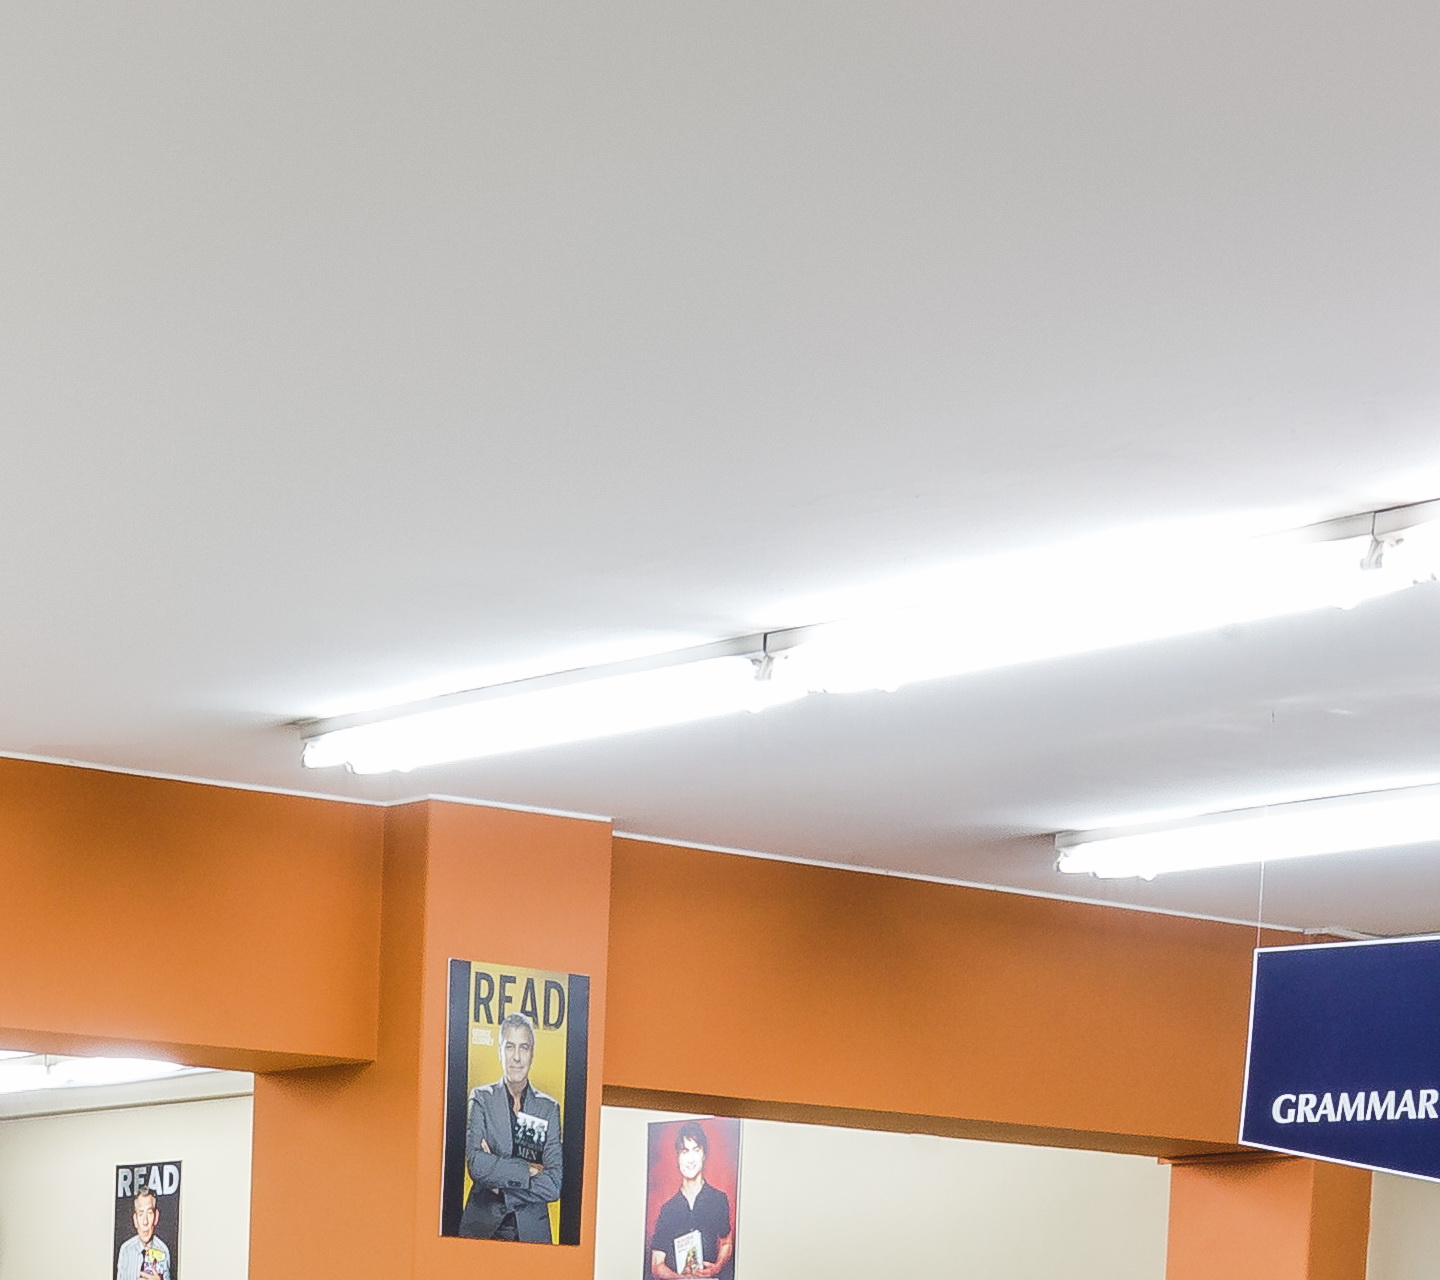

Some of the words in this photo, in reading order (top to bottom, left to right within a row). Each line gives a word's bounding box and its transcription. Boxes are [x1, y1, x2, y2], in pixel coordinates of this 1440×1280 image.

[474, 970, 566, 1030] READ
[1271, 1089, 1439, 1124] GRAMMAR
[117, 1164, 180, 1198] READ
